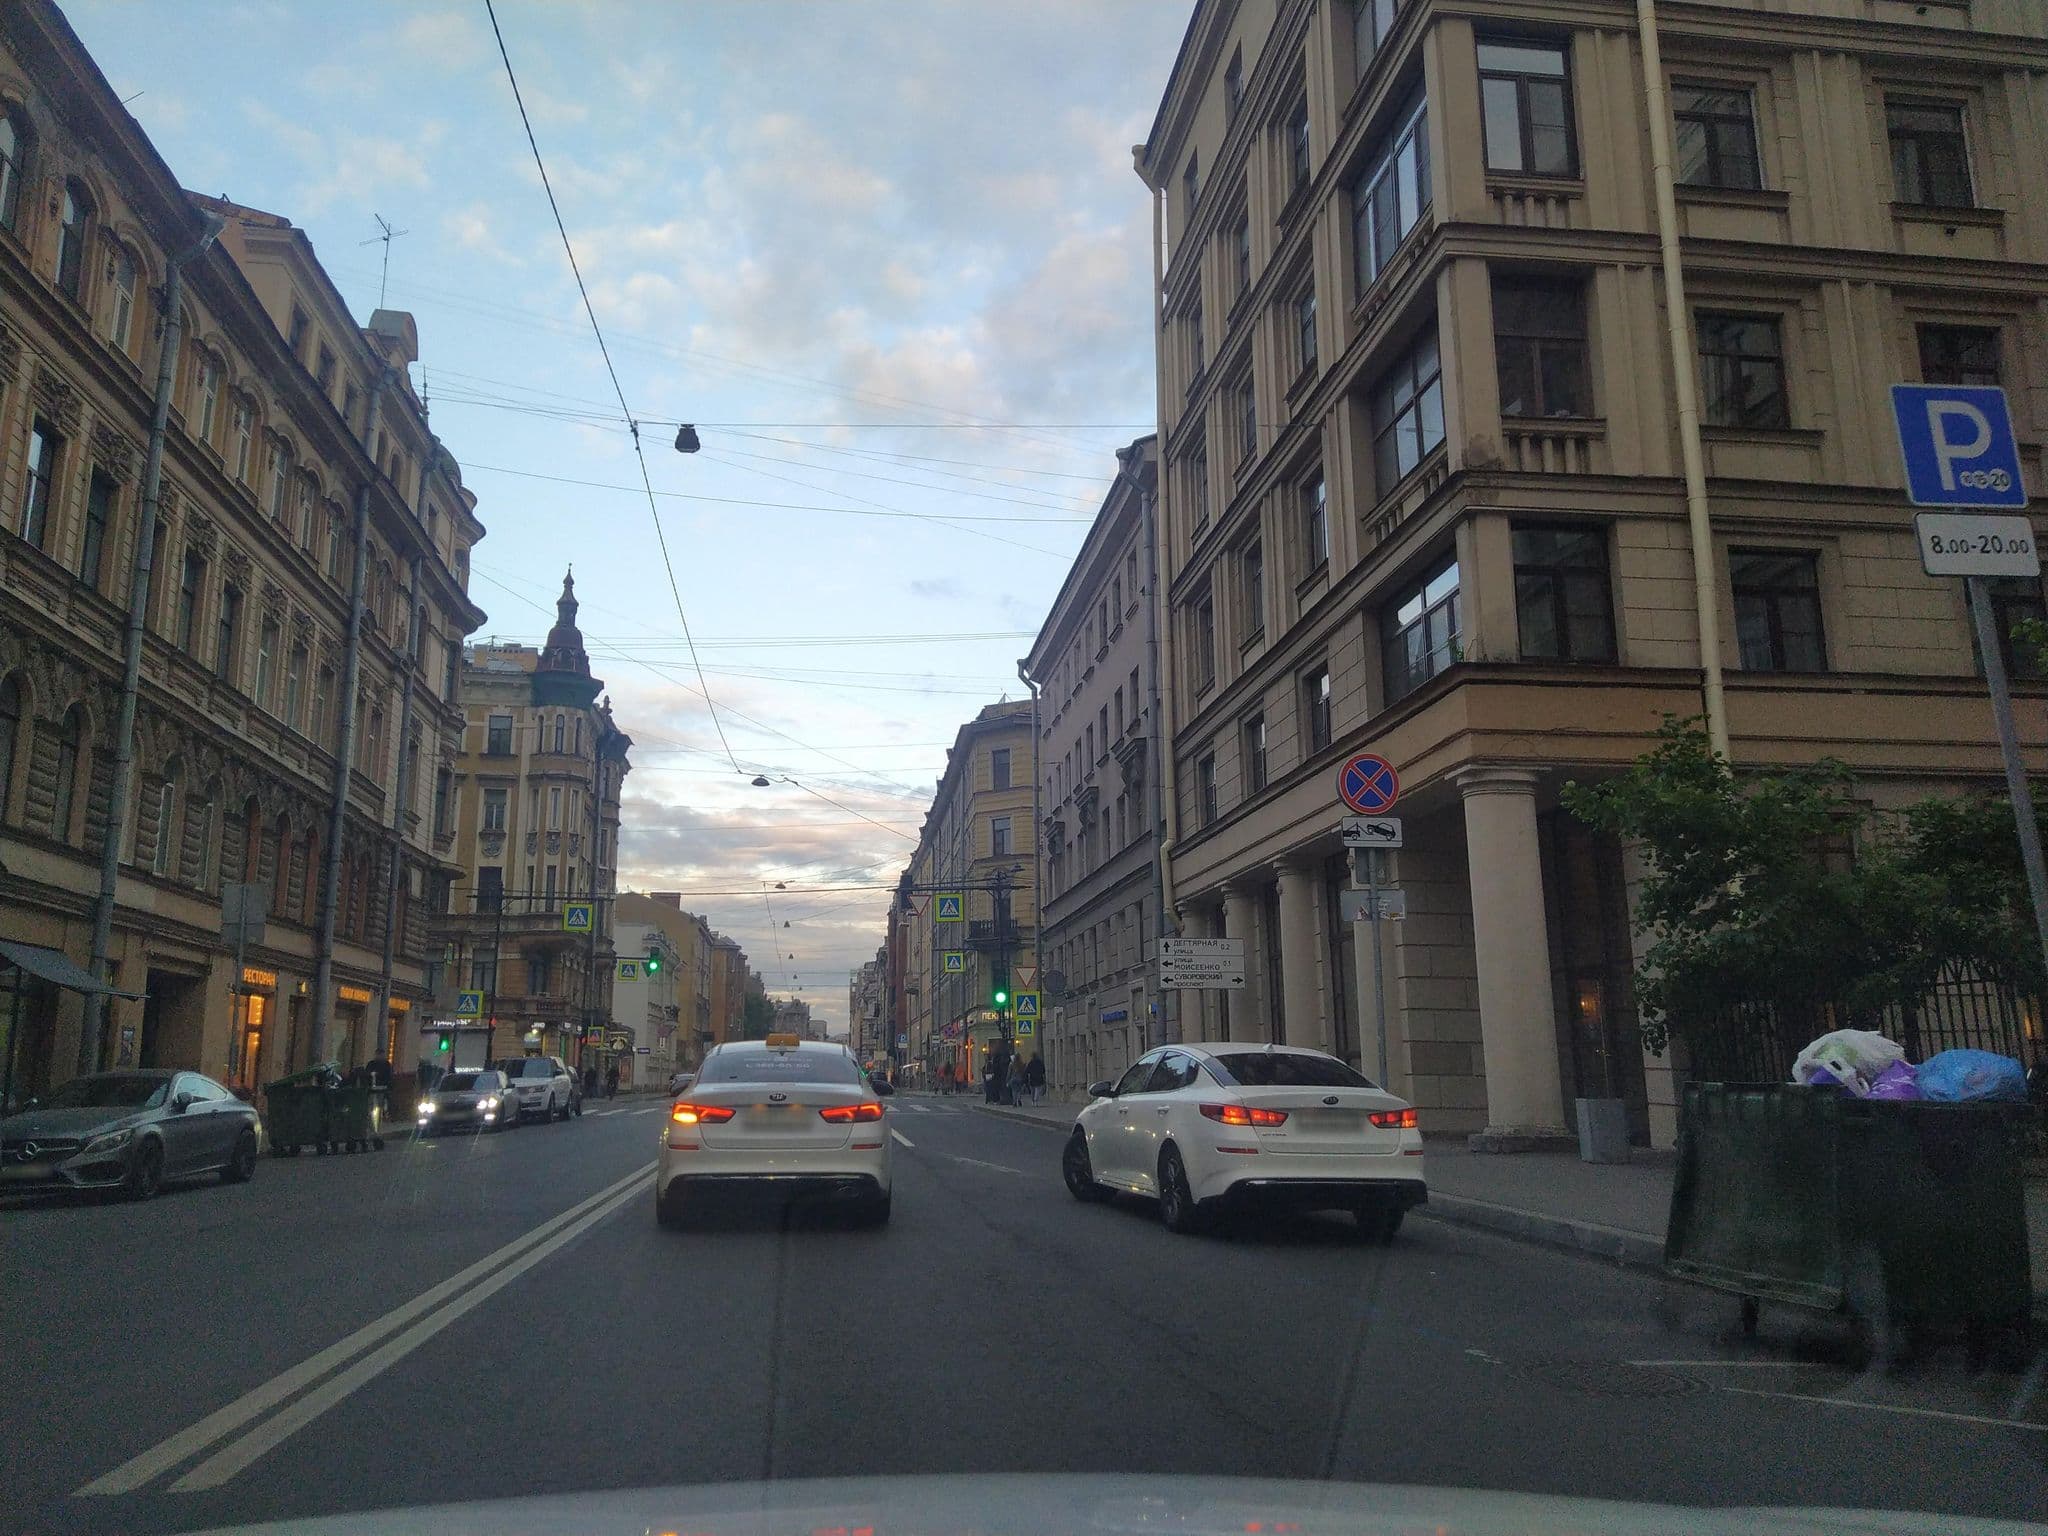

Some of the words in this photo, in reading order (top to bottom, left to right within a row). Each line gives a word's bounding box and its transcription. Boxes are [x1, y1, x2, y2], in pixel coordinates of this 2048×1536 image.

[1926, 399, 1993, 491] P
[1930, 534, 2029, 555] 8.00-20.00
[243, 967, 276, 986] РЕСТОРАН
[1174, 963, 1220, 971] МОИСЕЕНКО
[1174, 972, 1223, 980] СУВОРОВСКИЙ
